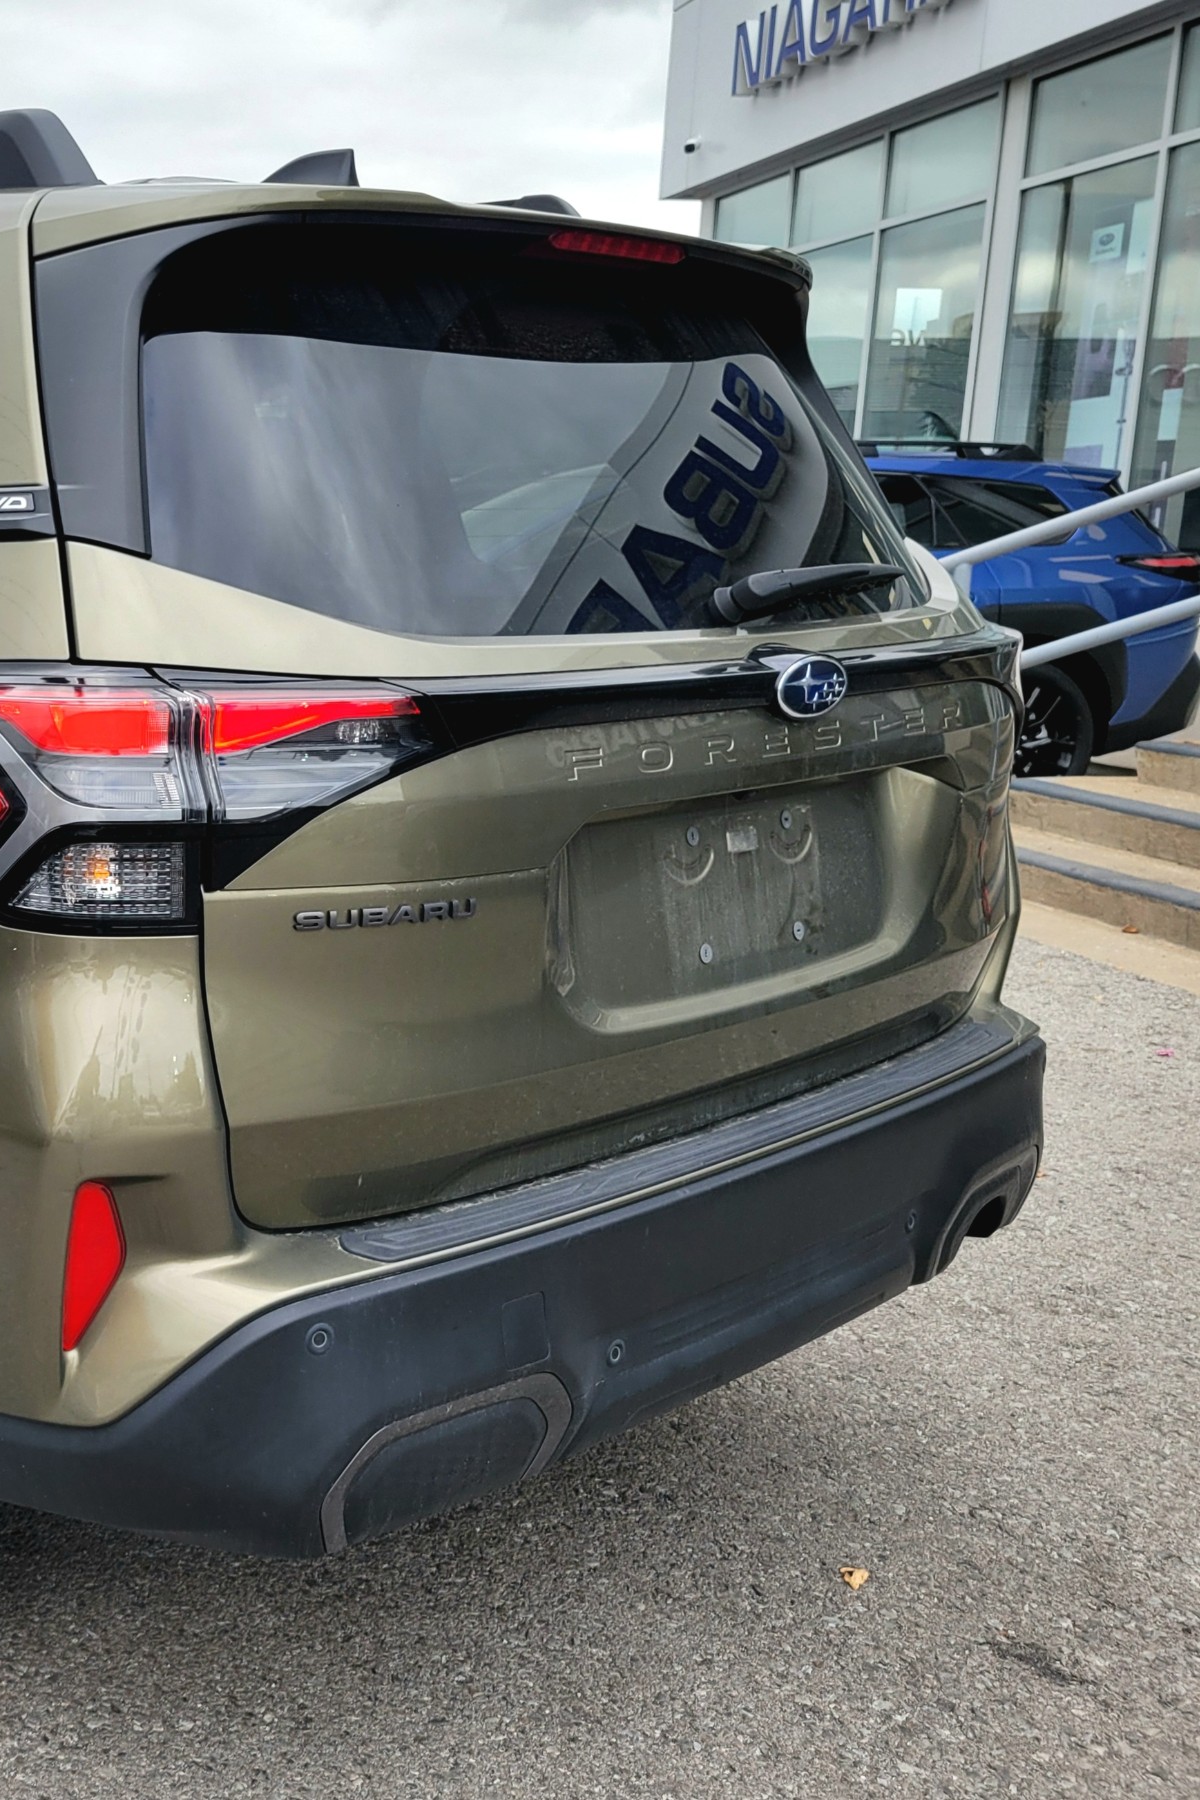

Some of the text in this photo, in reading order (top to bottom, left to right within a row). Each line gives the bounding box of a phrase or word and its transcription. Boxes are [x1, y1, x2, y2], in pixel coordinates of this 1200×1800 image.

[731, 0, 927, 96] NIAGA
[564, 700, 962, 782] FORESTER
[293, 898, 477, 931] SUBARU
